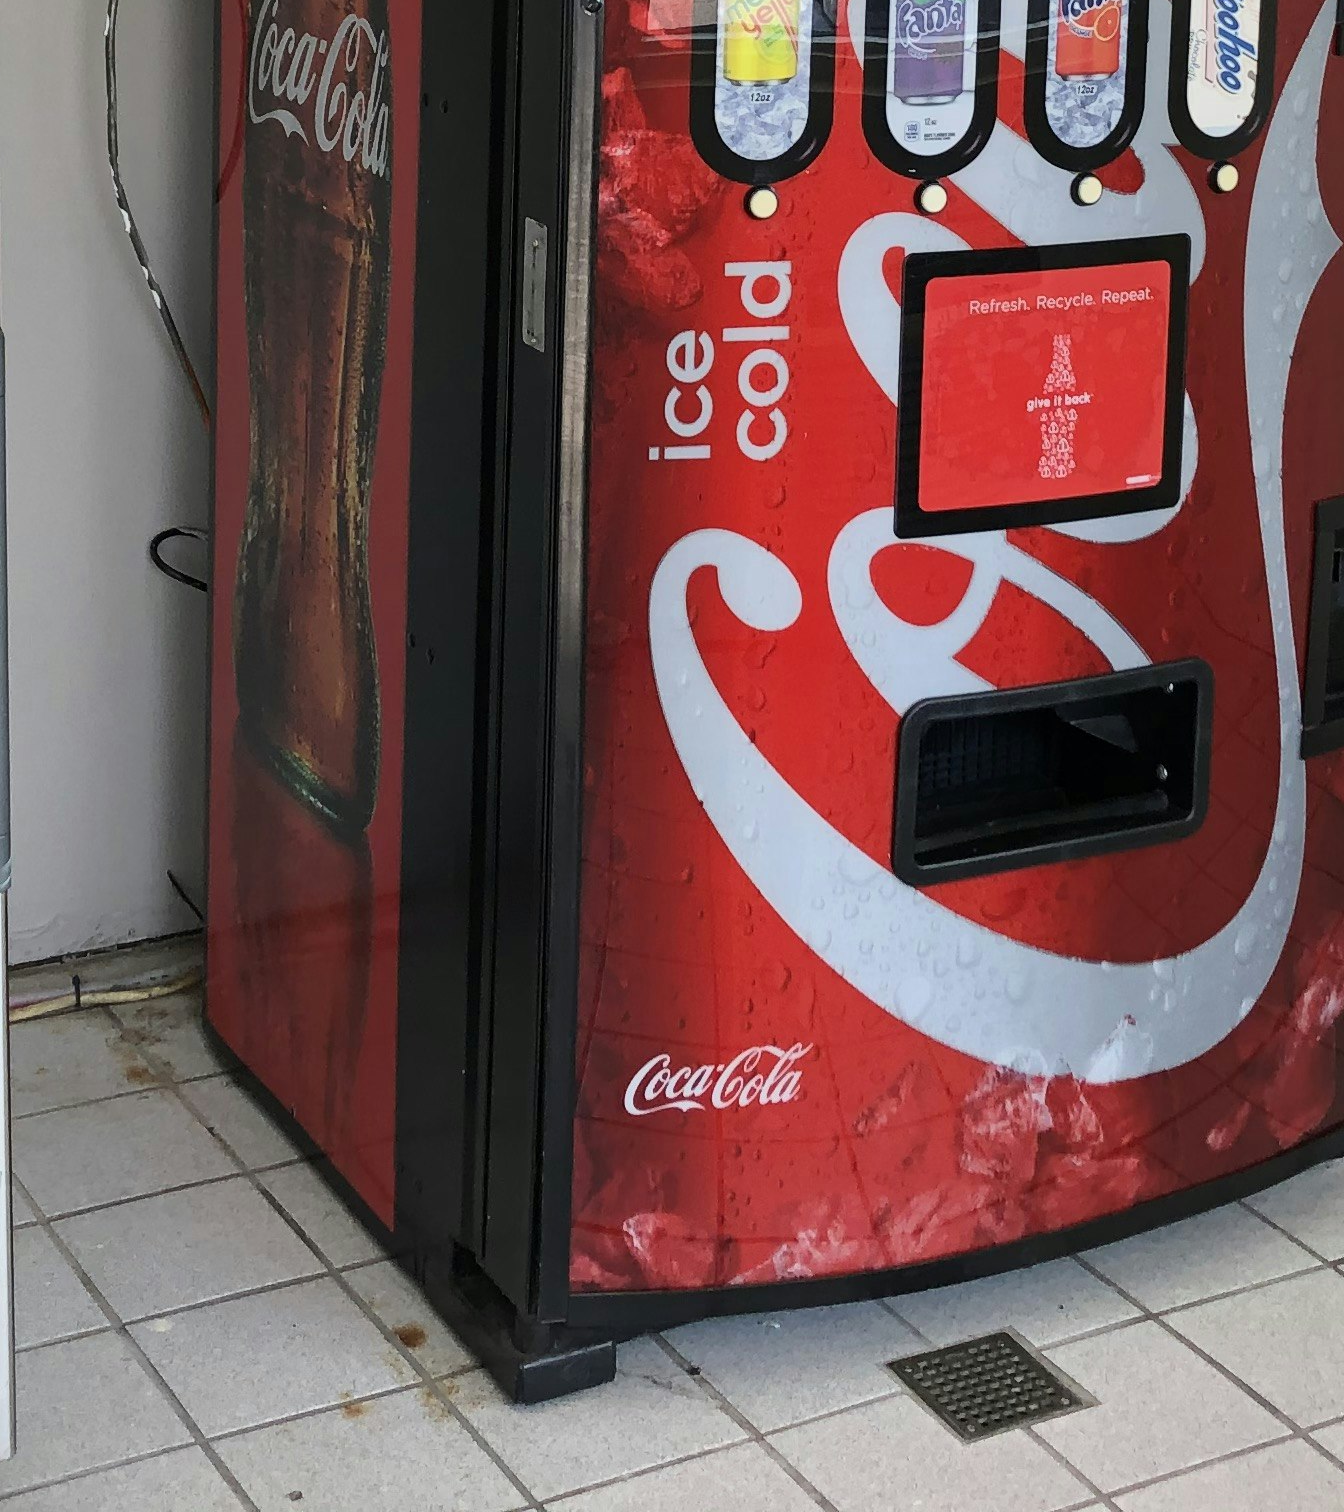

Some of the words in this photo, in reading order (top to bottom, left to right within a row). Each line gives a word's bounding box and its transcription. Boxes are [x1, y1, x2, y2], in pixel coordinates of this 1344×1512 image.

[750, 92, 771, 102] 12oz
[1076, 86, 1095, 94] 12oz
[969, 296, 1031, 315] Refresh.
[1036, 292, 1096, 312] Recycle.
[1101, 287, 1155, 305] Repeat.
[722, 260, 792, 462] cold
[649, 329, 715, 462] ice
[1026, 396, 1051, 413] give
[1053, 394, 1063, 408] it
[1065, 392, 1091, 407] back
[623, 1043, 814, 1117] Coca-Cola
